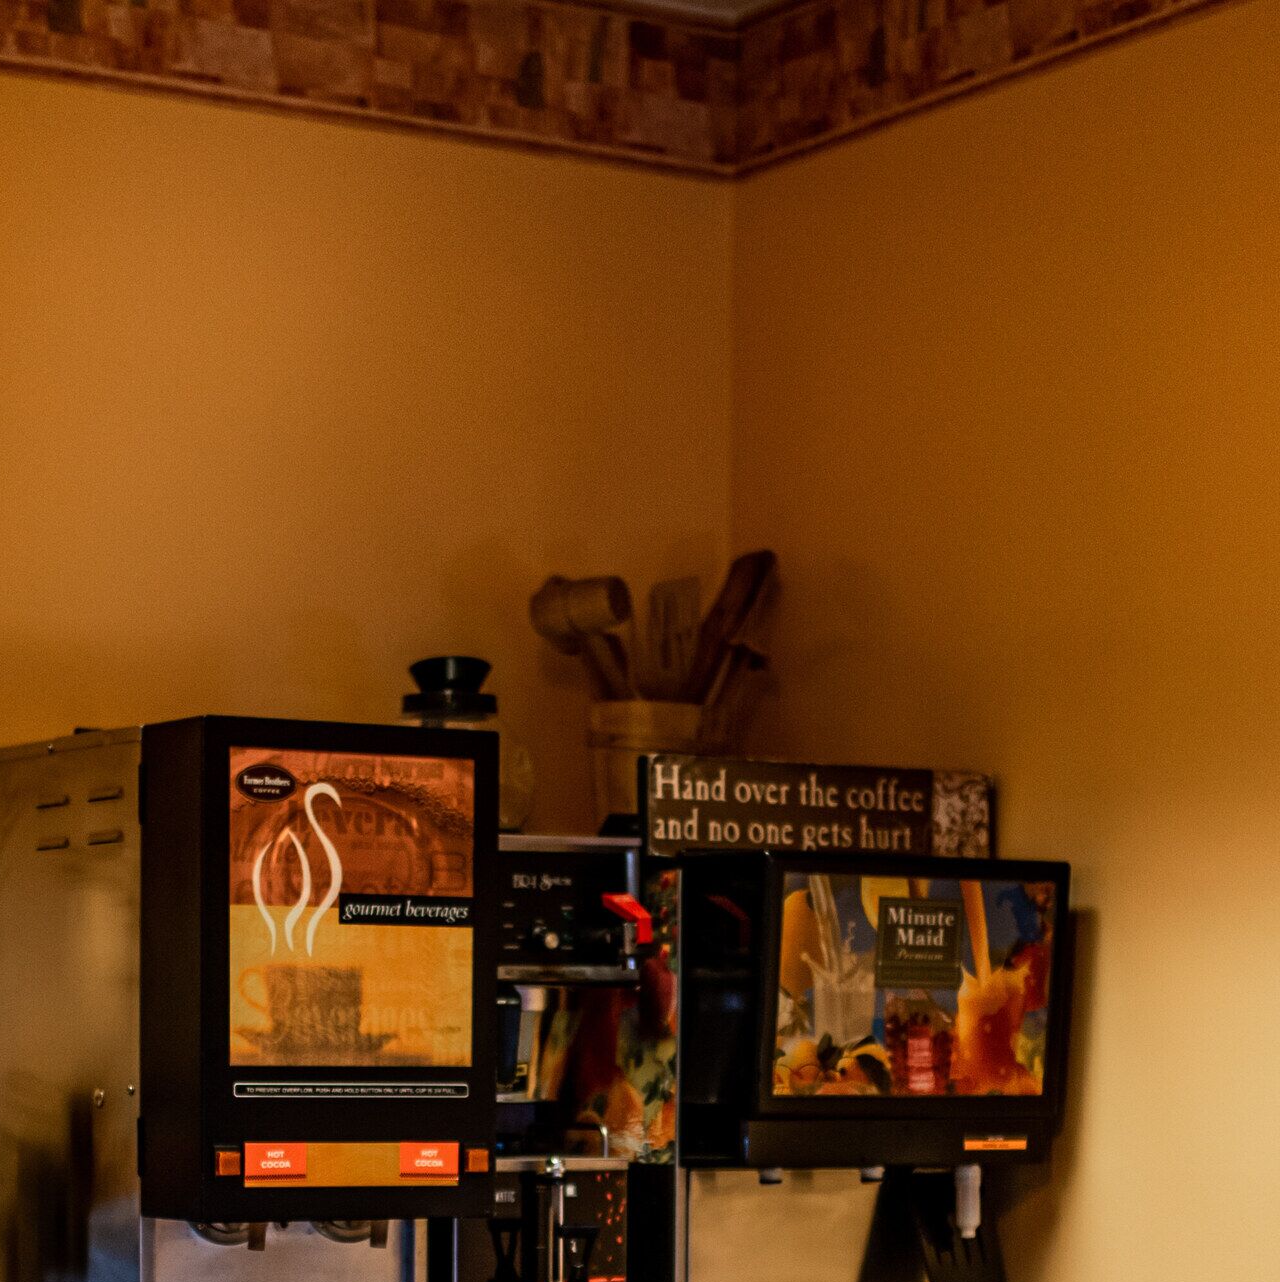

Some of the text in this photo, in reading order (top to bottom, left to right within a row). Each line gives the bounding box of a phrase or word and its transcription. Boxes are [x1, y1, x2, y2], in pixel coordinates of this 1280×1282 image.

[654, 764, 925, 812] Hand over the coffee
[654, 808, 912, 851] and no one gets hurt
[342, 900, 469, 923] gourmet beverages
[887, 907, 954, 926] Minute
[897, 928, 944, 947] Maid
[896, 948, 944, 961] Premium
[267, 1151, 285, 1159] HOT
[420, 1150, 438, 1158] HOT
[261, 1160, 291, 1169] COCOA
[415, 1159, 443, 1168] COCOA
